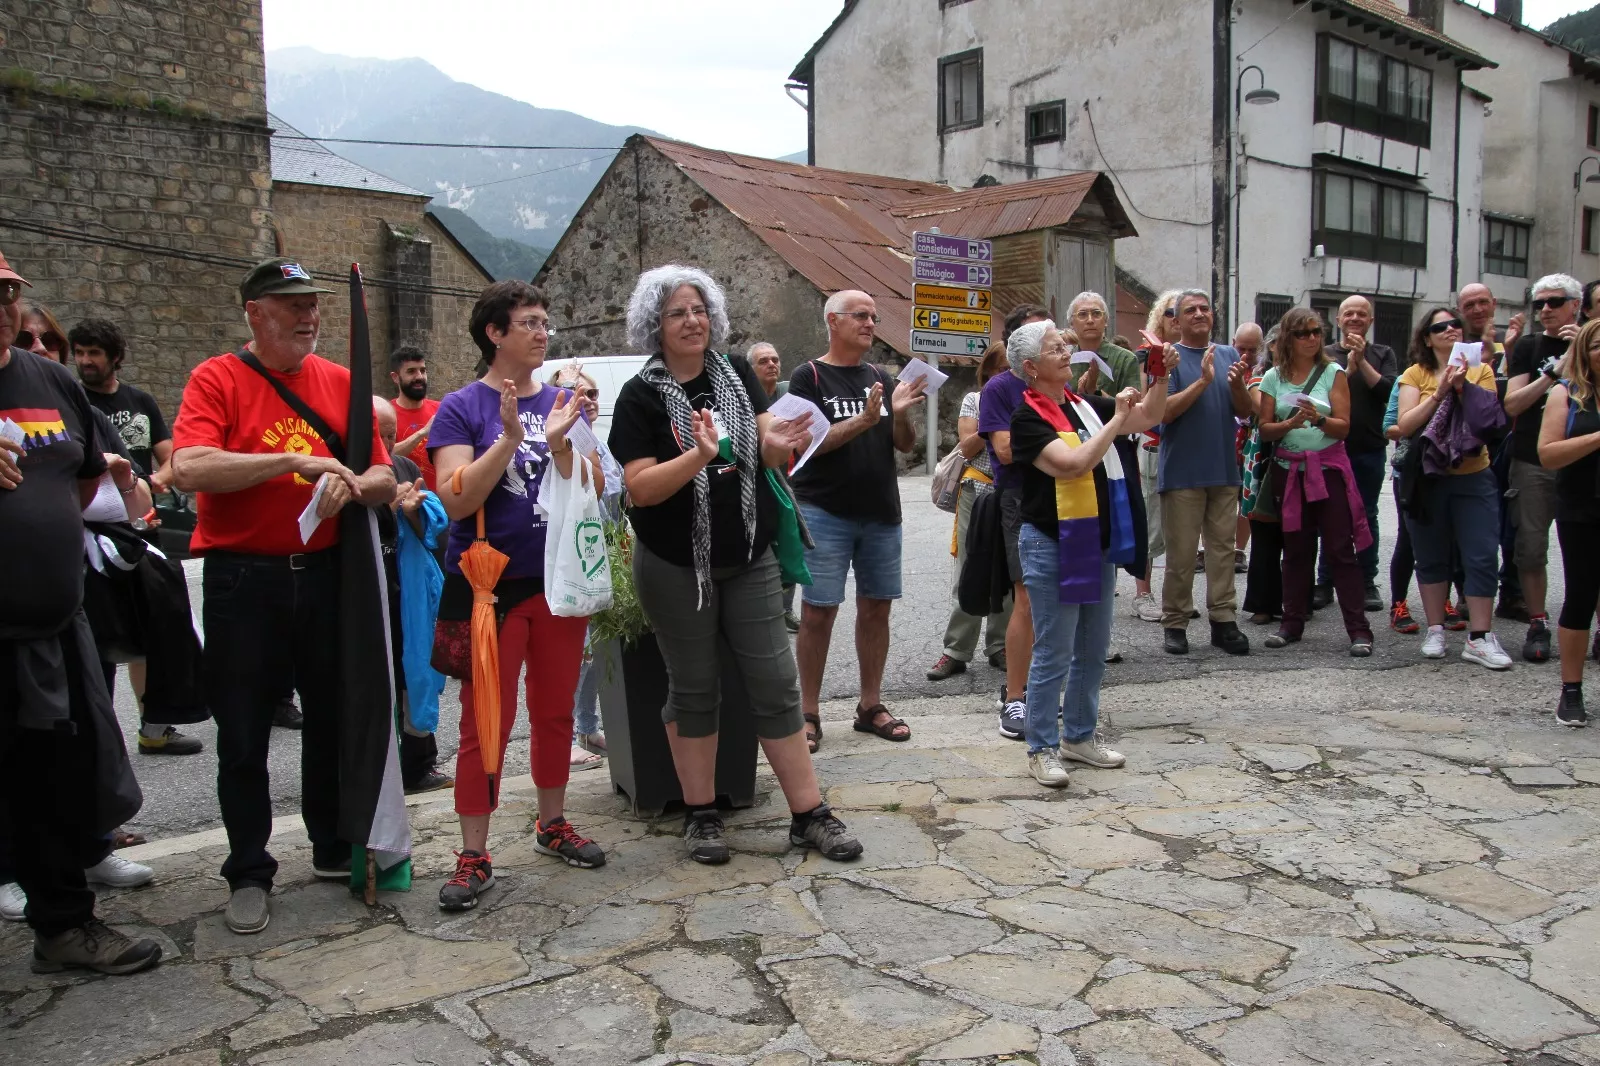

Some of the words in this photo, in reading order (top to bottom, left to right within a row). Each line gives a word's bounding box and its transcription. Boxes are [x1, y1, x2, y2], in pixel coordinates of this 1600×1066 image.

[917, 235, 935, 245] casa
[917, 243, 960, 256] consistorial
[917, 266, 955, 280] Etnológico
[930, 312, 938, 327] P
[914, 337, 947, 348] farmacia
[261, 428, 281, 449] NO
